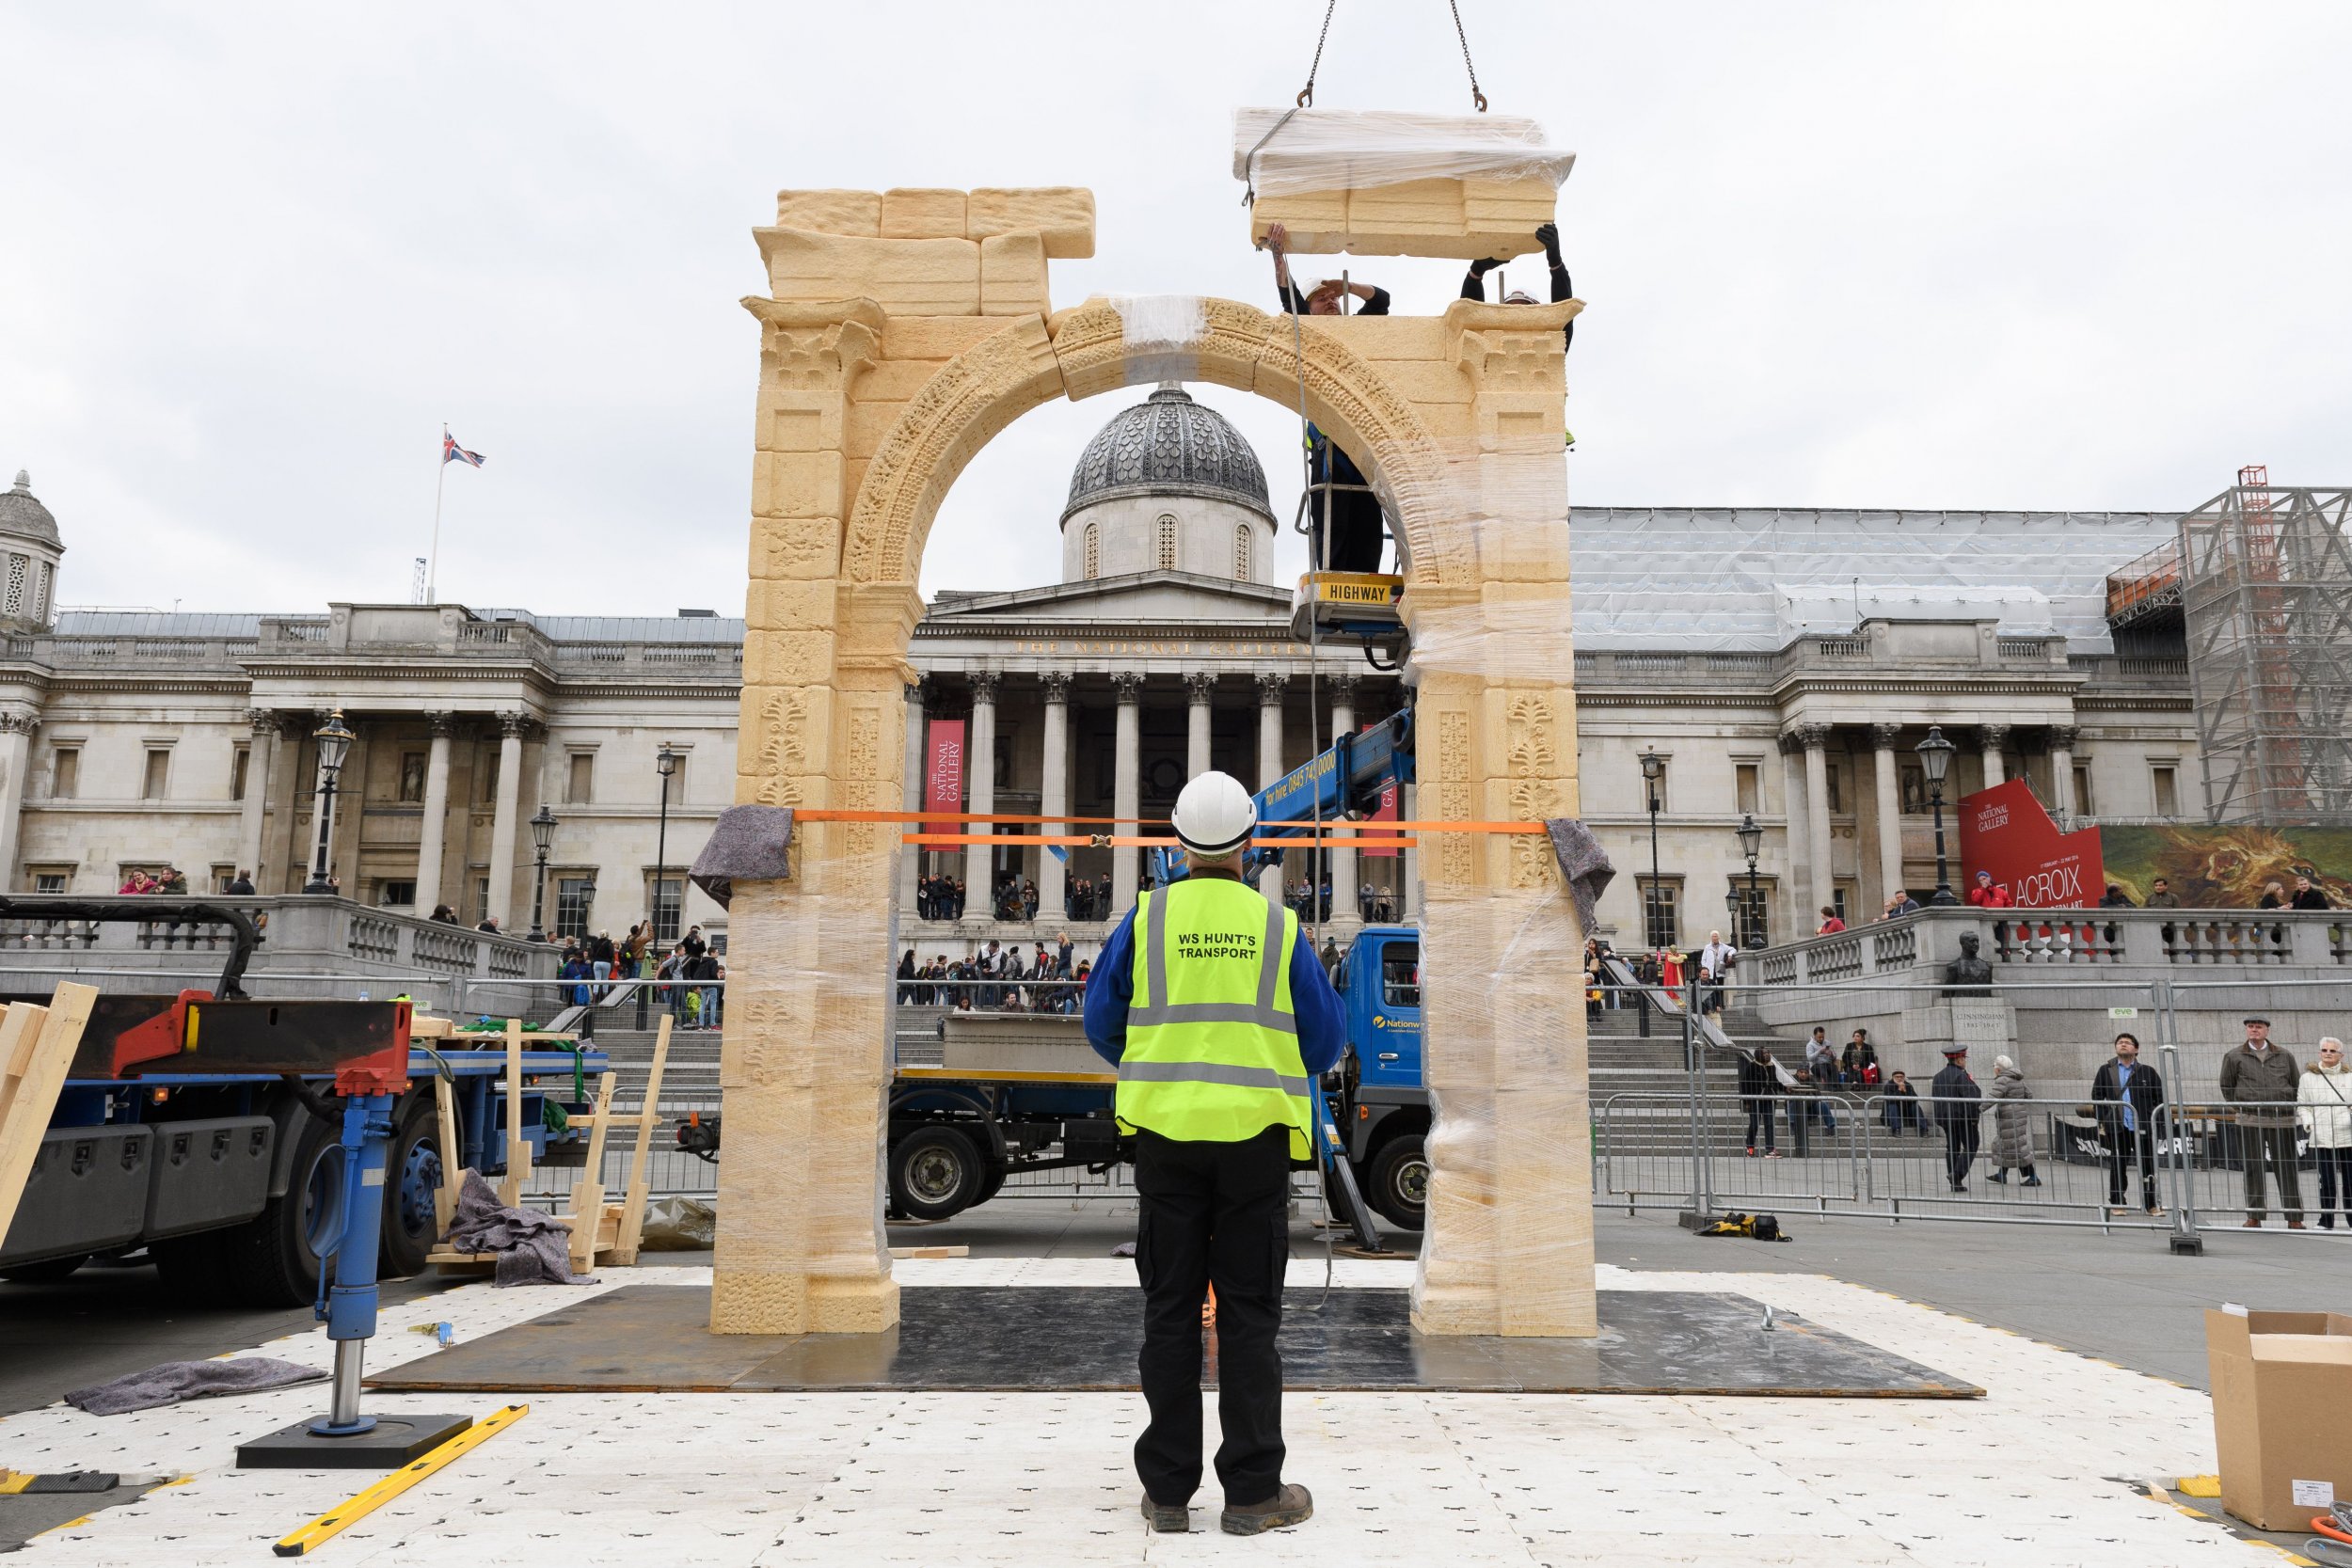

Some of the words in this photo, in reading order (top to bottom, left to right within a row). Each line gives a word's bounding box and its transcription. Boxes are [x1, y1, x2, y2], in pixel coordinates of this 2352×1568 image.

[1329, 584, 1386, 601] HIGHWAY
[1016, 641, 1057, 654] THE
[1074, 641, 1193, 655] NATIONAL
[1209, 641, 1313, 656] GALLERY
[937, 740, 948, 801] NATIONAL
[947, 741, 960, 801] GALLERY
[1289, 769, 1304, 793] 0845
[1978, 804, 2009, 821] NATIONAL
[1979, 814, 2009, 832] GALLERY
[1179, 933, 1200, 945] WS
[1204, 933, 1256, 946] HUNT'S
[1179, 947, 1256, 959] TRANSPORT
[1387, 1020, 1421, 1028] Nationw
